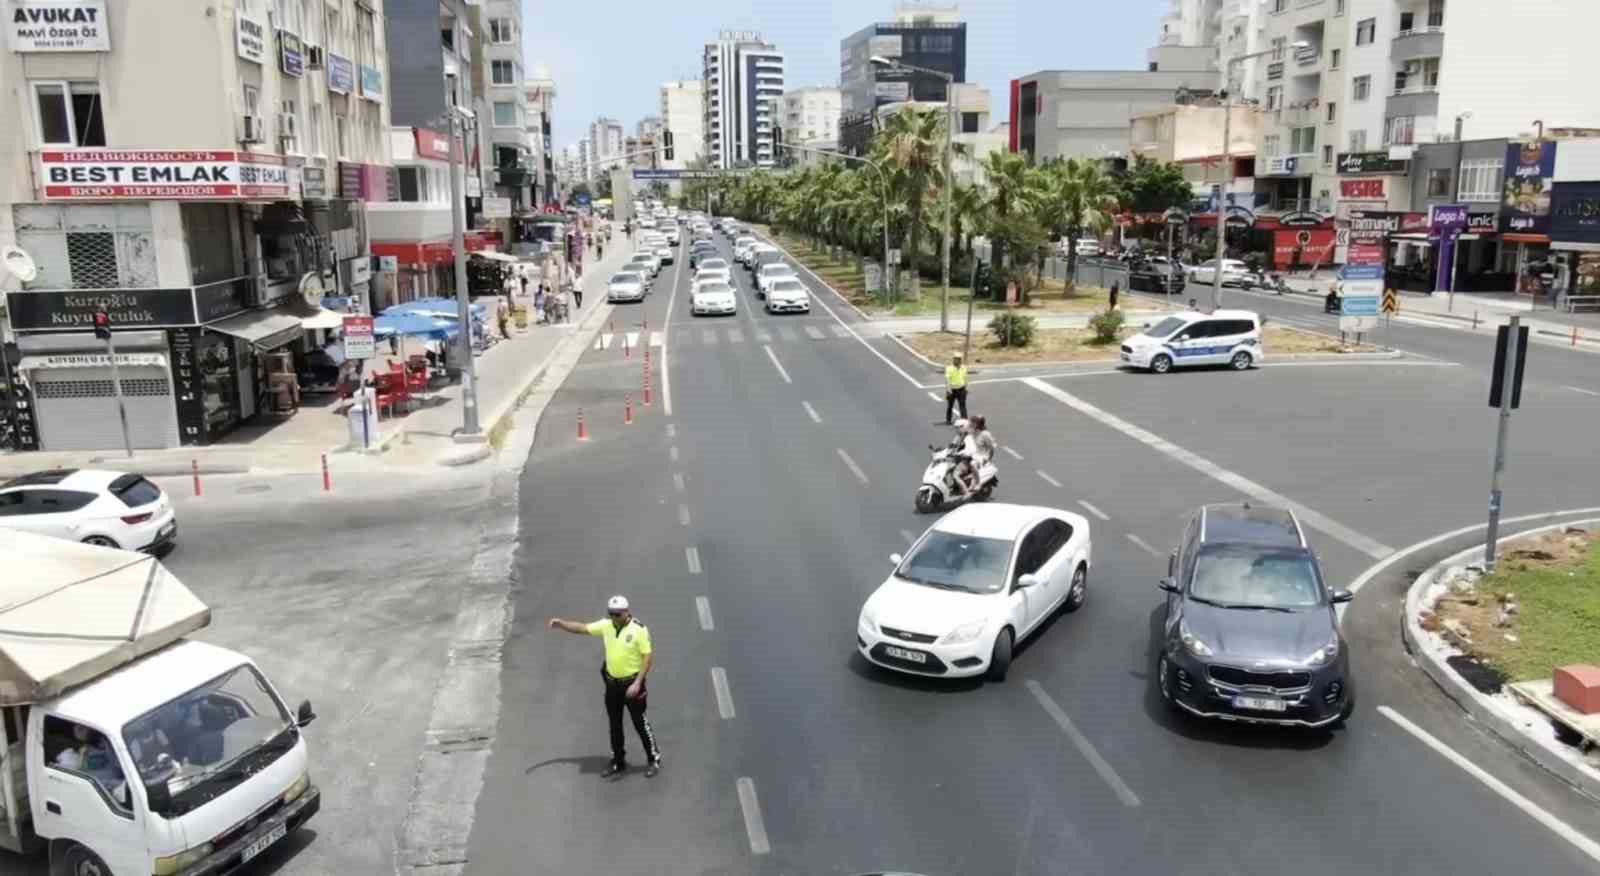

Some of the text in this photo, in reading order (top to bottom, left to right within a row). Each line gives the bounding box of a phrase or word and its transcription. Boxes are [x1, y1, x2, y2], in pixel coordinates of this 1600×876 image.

[14, 8, 97, 23] AVUKAT
[17, 26, 97, 38] MAVİ ÖZGE ÖZ
[63, 151, 216, 162] НЕДВИЖИМОСТЬ
[50, 166, 230, 183] BEST EMLAK
[239, 166, 261, 183] BEST
[71, 186, 216, 196] БЮРО ПЕРЕВОДОВ
[51, 311, 154, 327] Kuyuculuk
